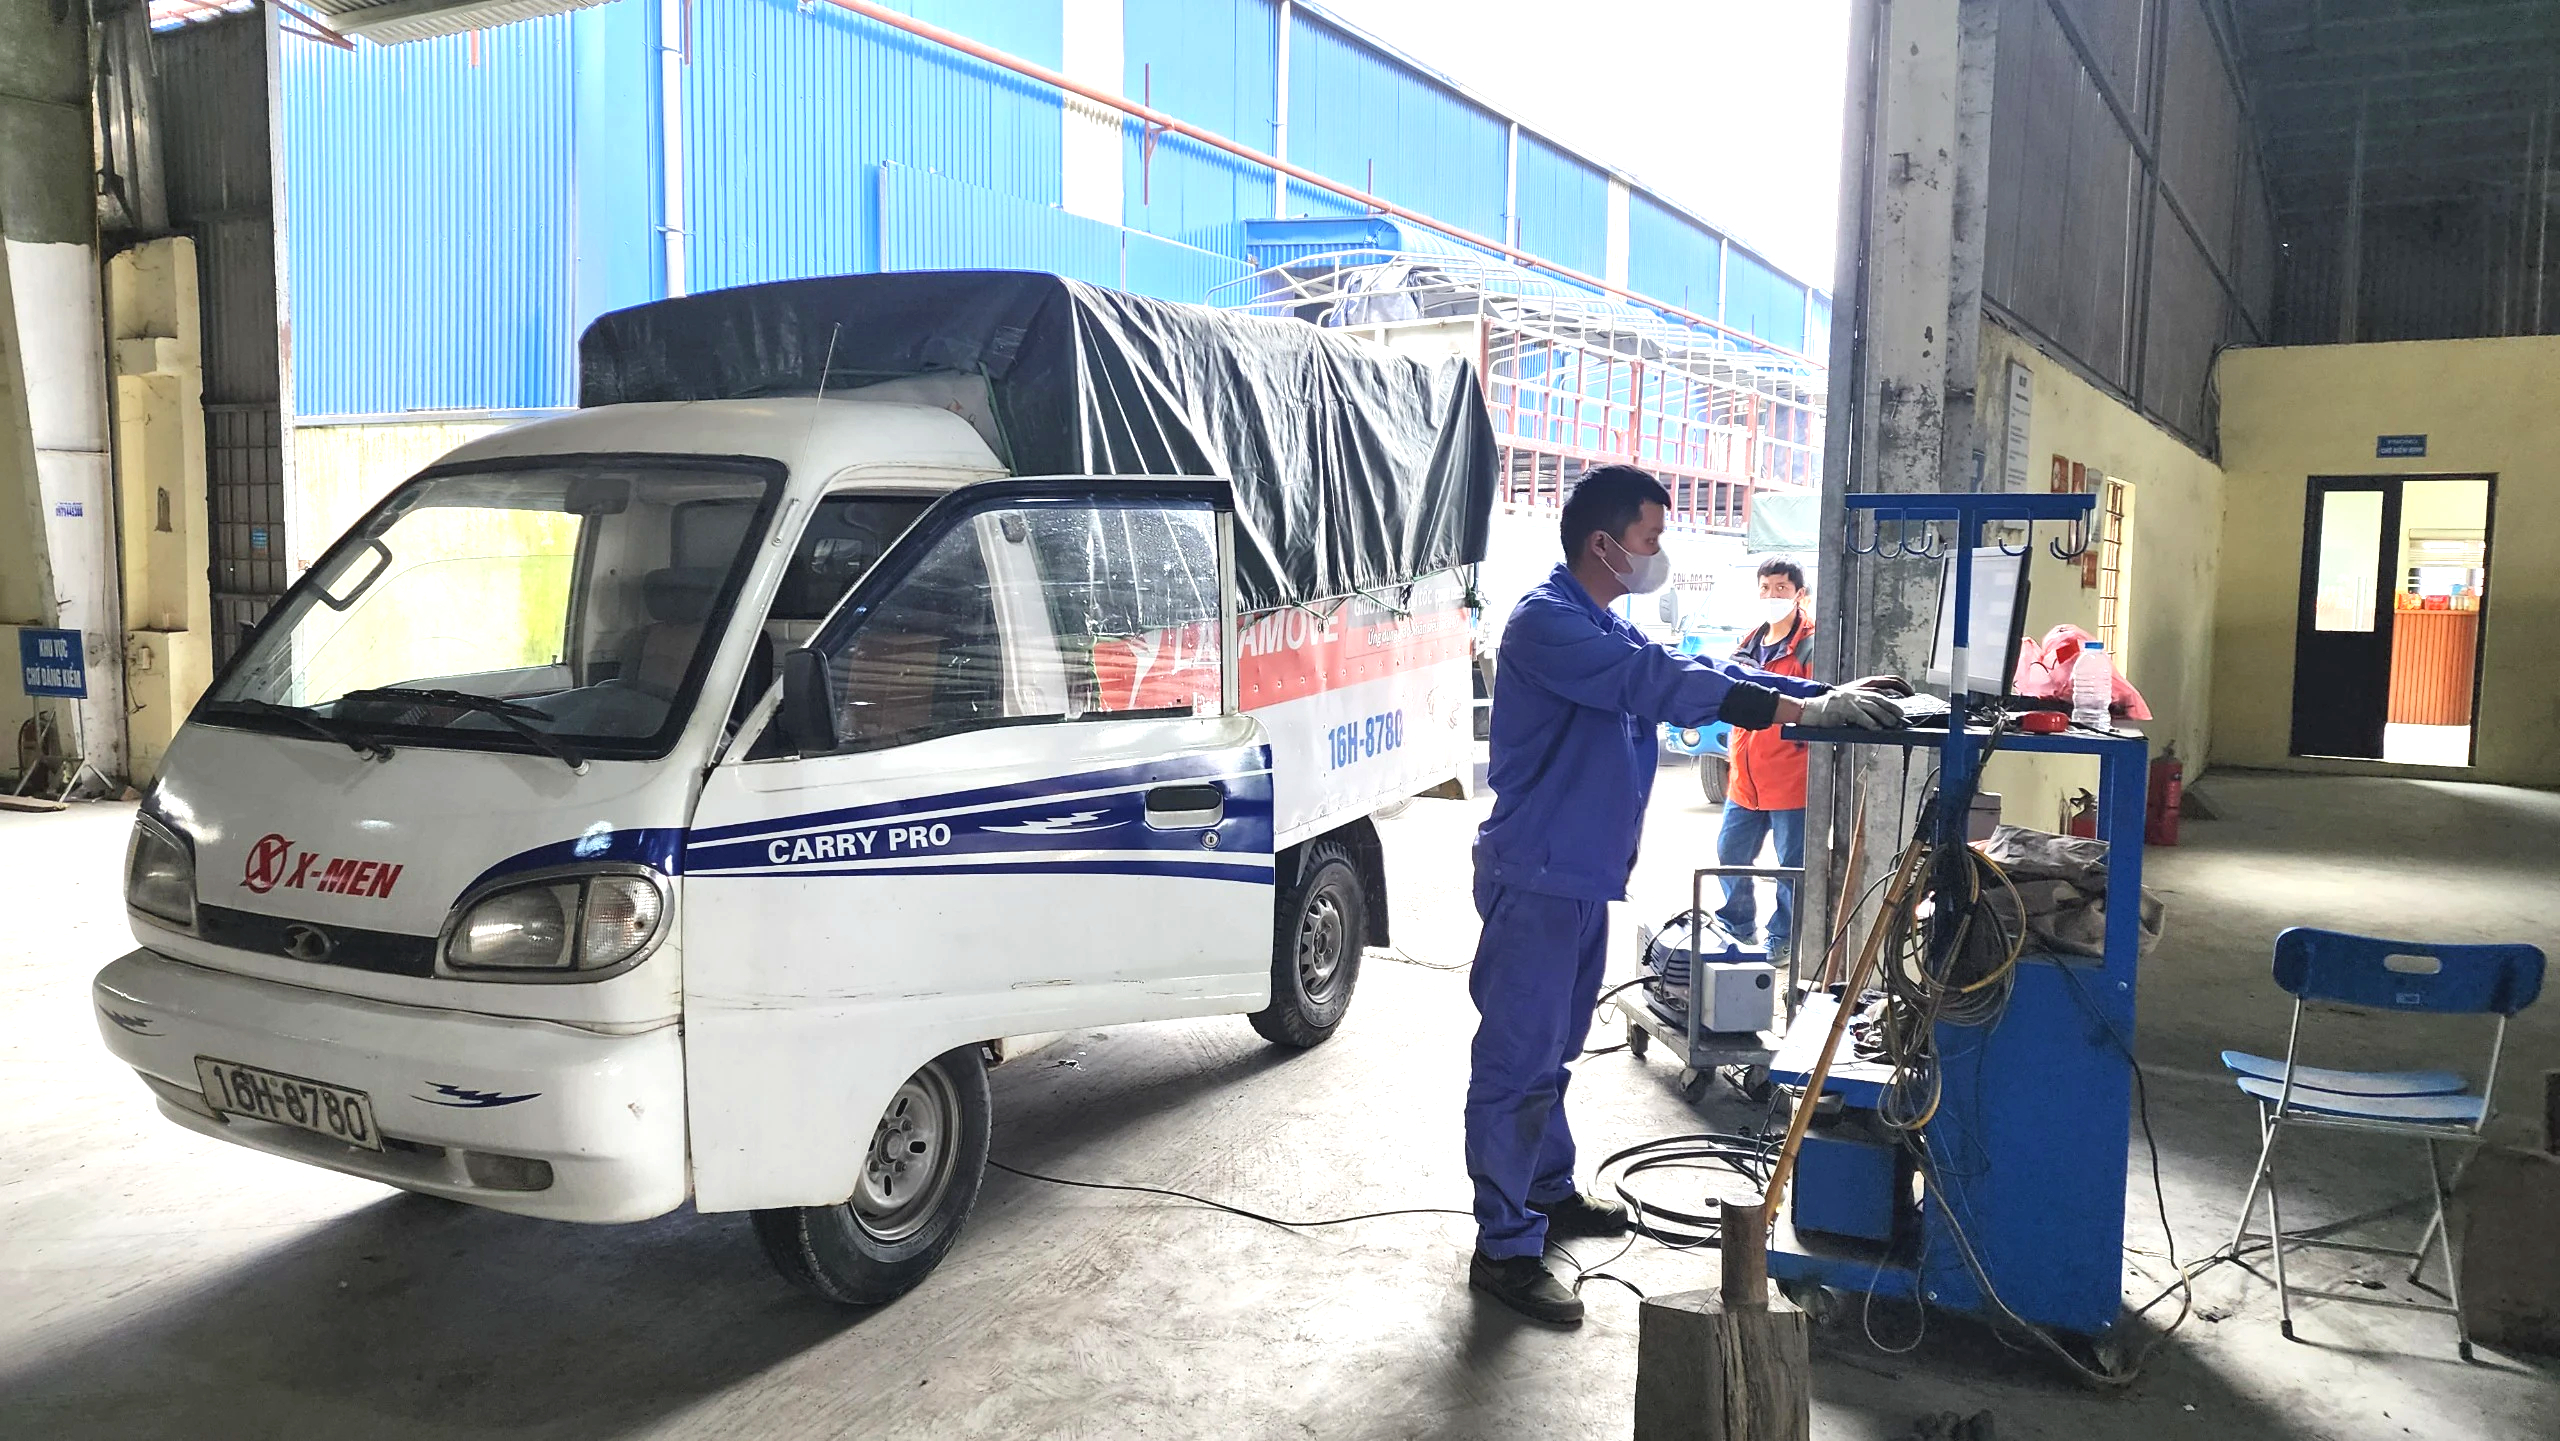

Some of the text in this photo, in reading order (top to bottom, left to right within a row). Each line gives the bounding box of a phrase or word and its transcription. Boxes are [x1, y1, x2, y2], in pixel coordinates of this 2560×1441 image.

[39, 638, 68, 661] KHU VỰC
[1328, 709, 1403, 770] 16H-8780
[768, 823, 951, 864] CARRY PRO
[284, 852, 404, 898] X-MEN
[213, 1065, 367, 1141] 16H-8780
